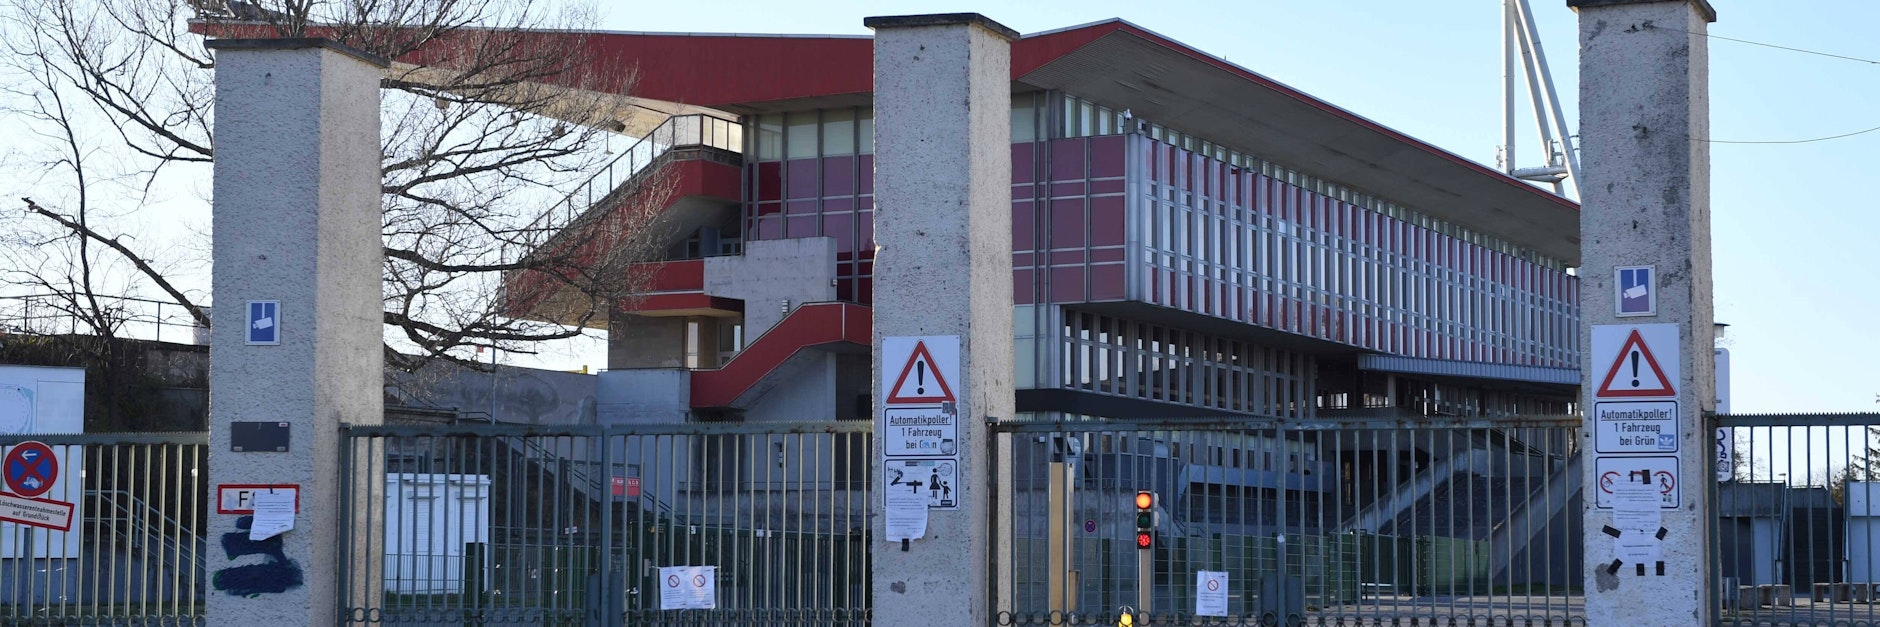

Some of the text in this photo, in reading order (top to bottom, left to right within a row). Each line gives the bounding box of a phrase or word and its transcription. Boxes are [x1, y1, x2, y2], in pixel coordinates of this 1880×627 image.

[1601, 408, 1672, 420] Automatikpoller!
[890, 415, 952, 426] Automatikpoller!
[901, 428, 942, 438] 1 Fahrzeug
[1614, 423, 1661, 434] 1 Fahrzeug
[906, 440, 917, 449] bei
[1619, 435, 1655, 445] bei Grün
